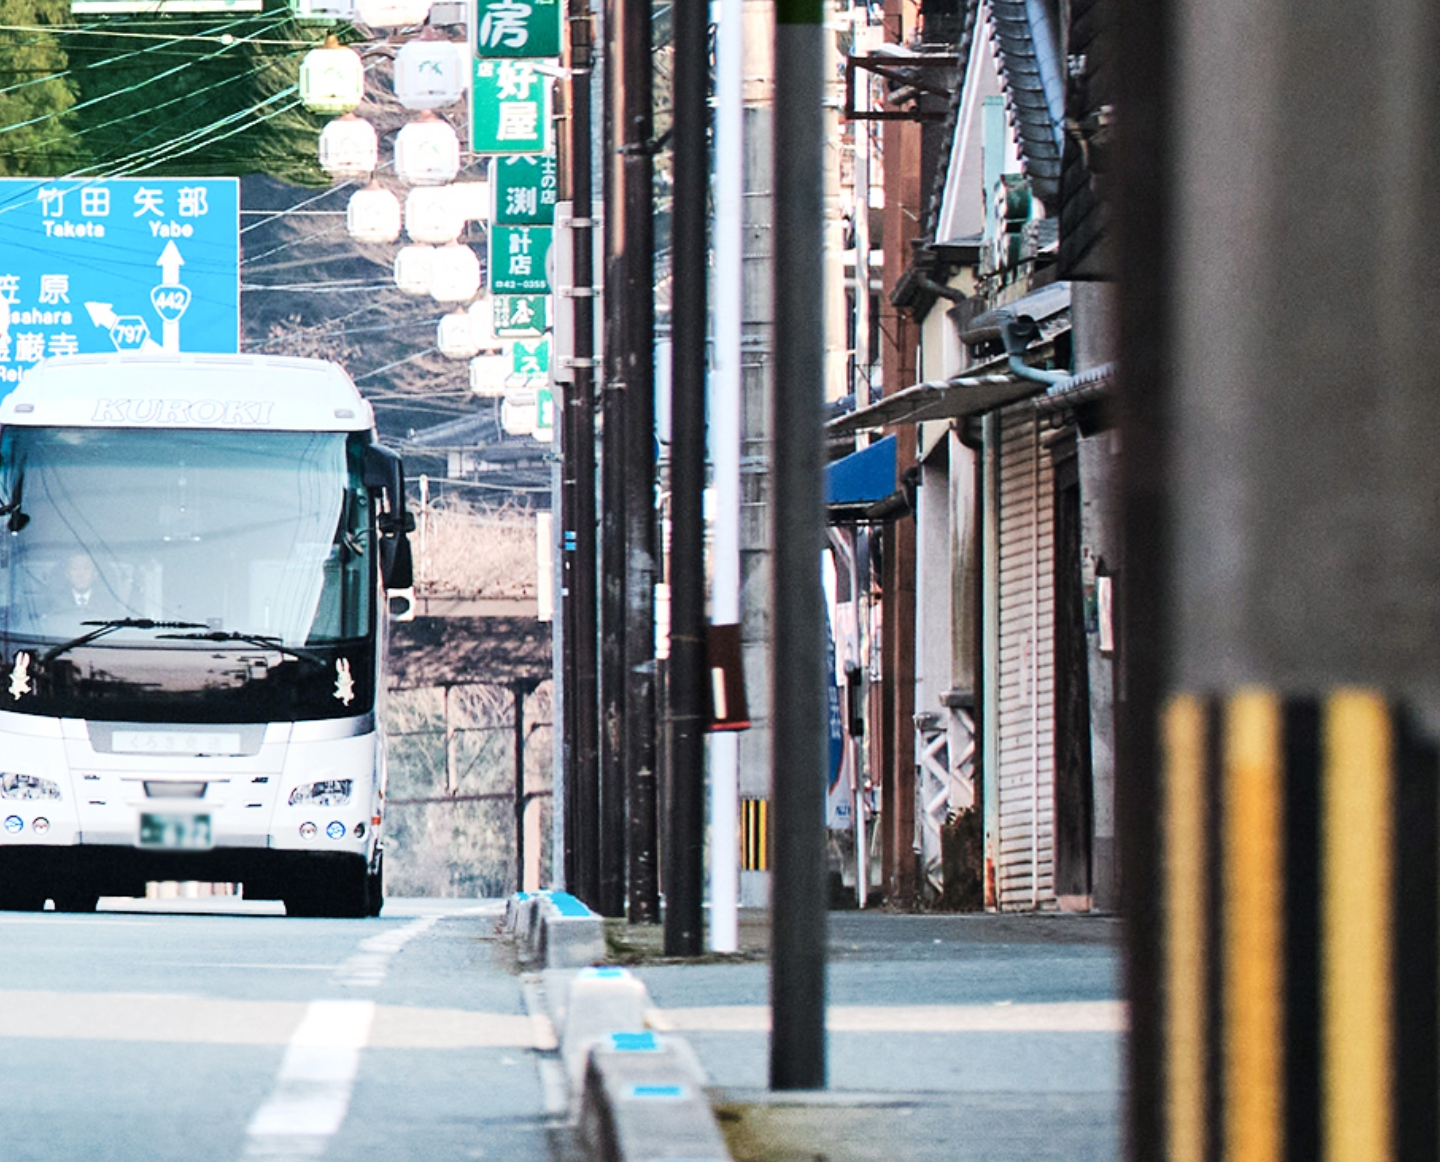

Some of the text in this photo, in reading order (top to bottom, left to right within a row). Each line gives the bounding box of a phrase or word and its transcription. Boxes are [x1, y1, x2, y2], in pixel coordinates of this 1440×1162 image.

[540, 155, 557, 204] 士の店
[37, 186, 208, 217] 竹田 矢部
[42, 220, 194, 238] Taketa Yabe
[508, 228, 532, 275] 計店
[157, 291, 186, 309] 442
[10, 307, 74, 325] sahara
[116, 325, 146, 344] 797
[91, 398, 275, 425] KUROKI
